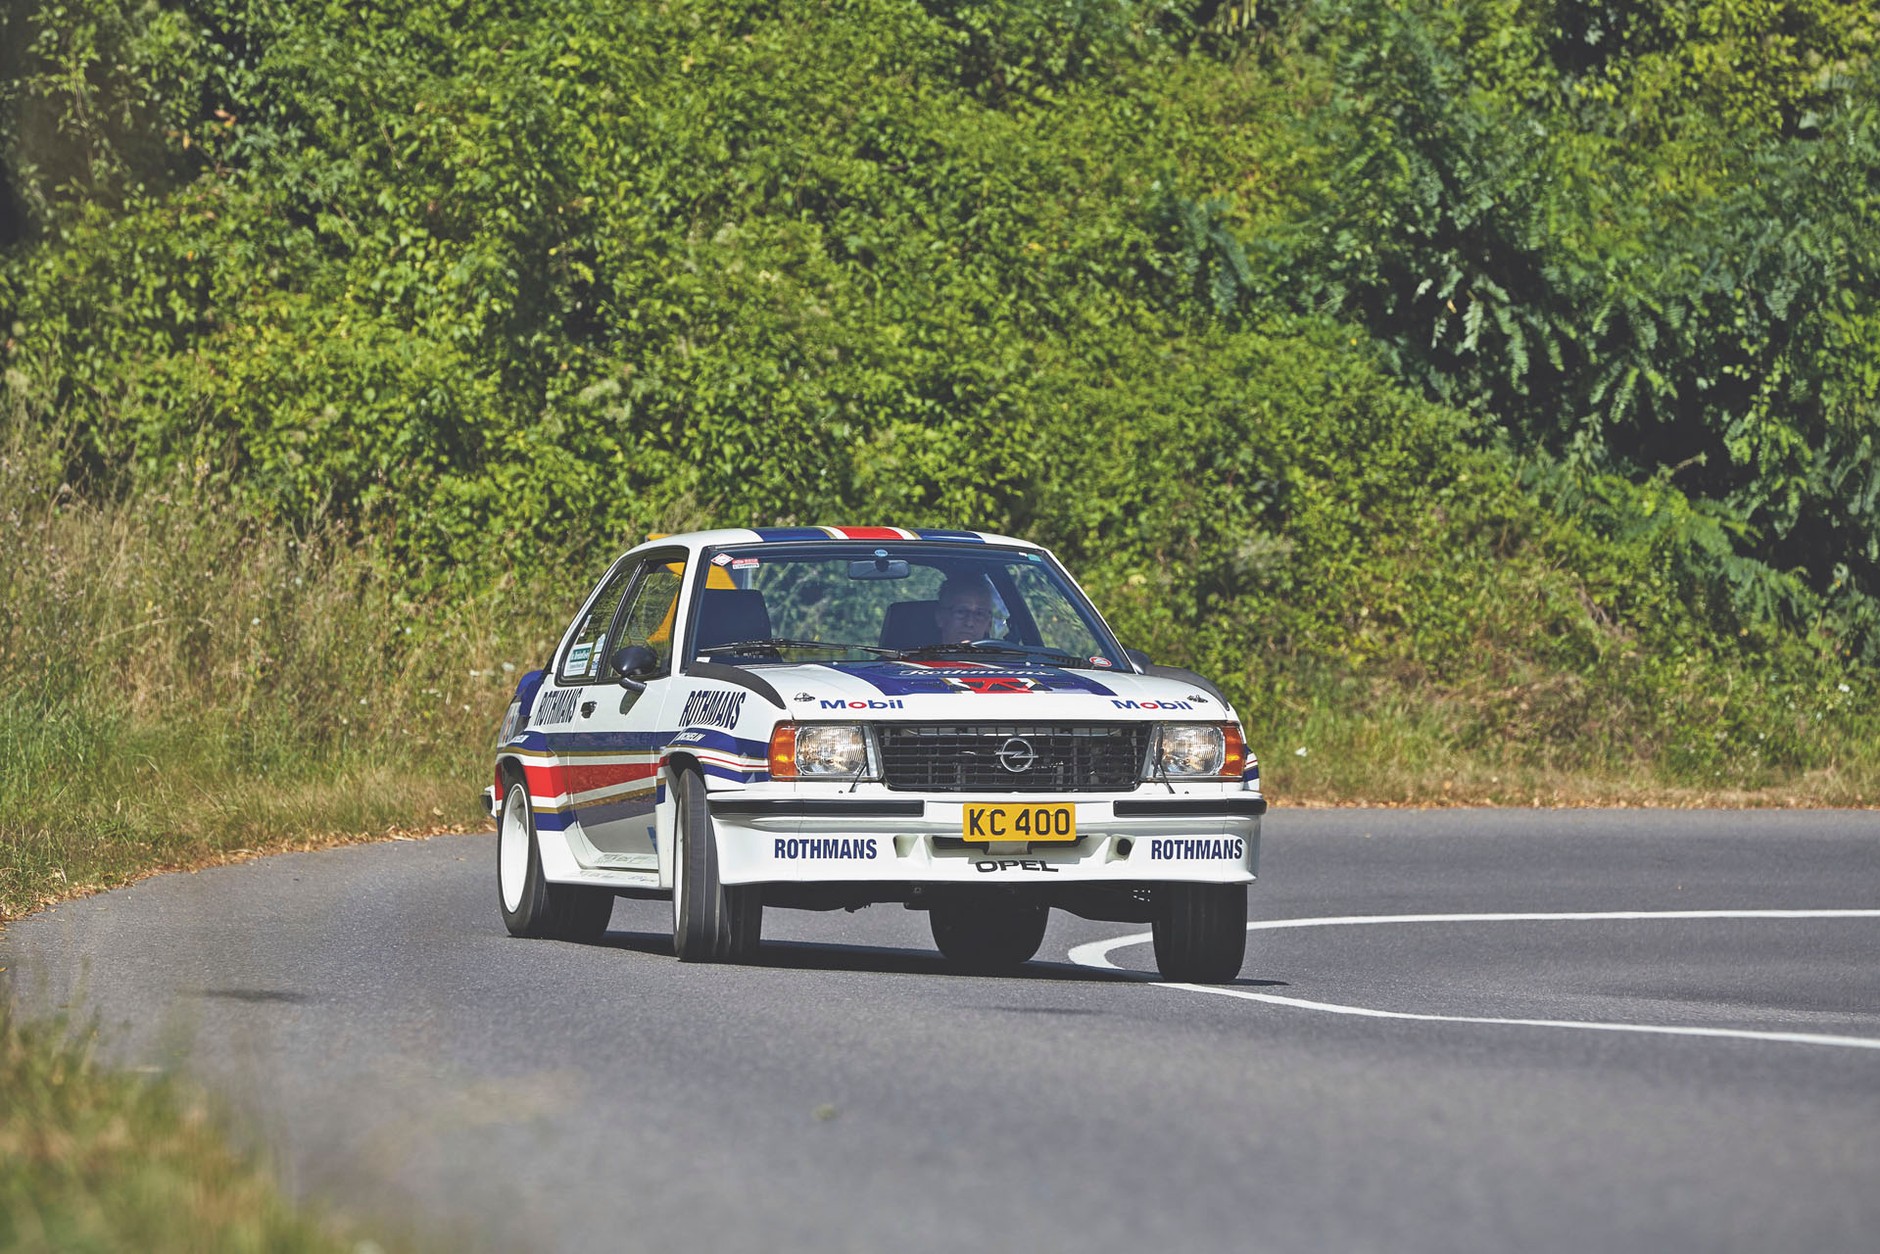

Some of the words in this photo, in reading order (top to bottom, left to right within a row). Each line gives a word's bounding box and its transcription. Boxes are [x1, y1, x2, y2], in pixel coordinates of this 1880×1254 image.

[899, 667, 1055, 677] Rothmans
[534, 687, 583, 726] ROTHMANS
[678, 690, 747, 731] ROTHMANS
[820, 699, 904, 710] Mobil
[1111, 699, 1194, 711] Mobil
[969, 808, 1006, 836] KC
[1015, 808, 1070, 836] 400
[774, 838, 878, 860] ROTHMANS
[1151, 838, 1243, 860] ROTHMANS
[975, 859, 1059, 873] OPEL
